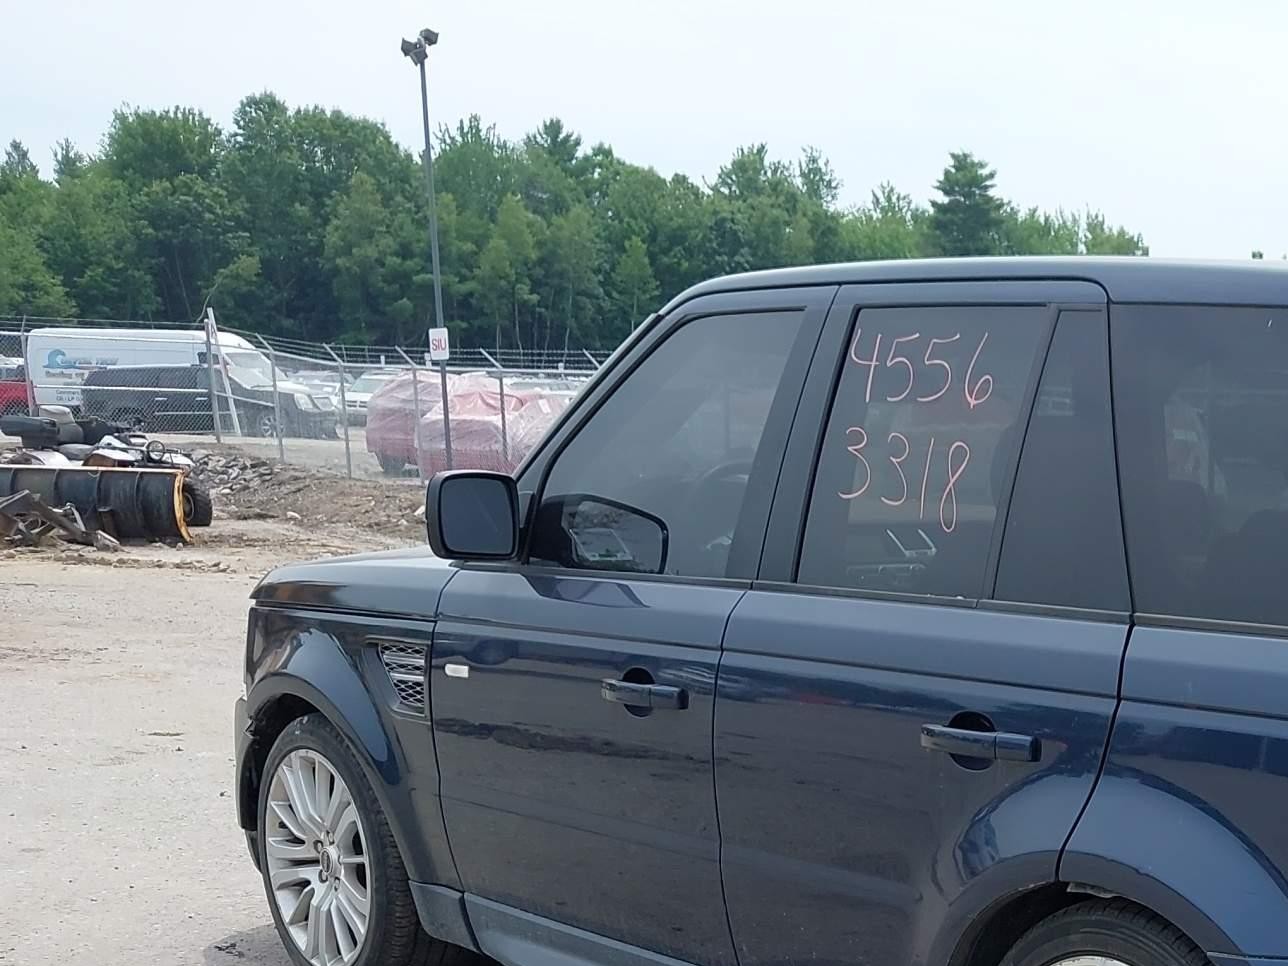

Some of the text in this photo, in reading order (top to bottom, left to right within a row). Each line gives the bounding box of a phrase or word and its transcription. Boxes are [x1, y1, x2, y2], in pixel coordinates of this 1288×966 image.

[431, 338, 447, 351] SIU
[850, 328, 993, 409] 4556
[838, 427, 970, 532] 3318
